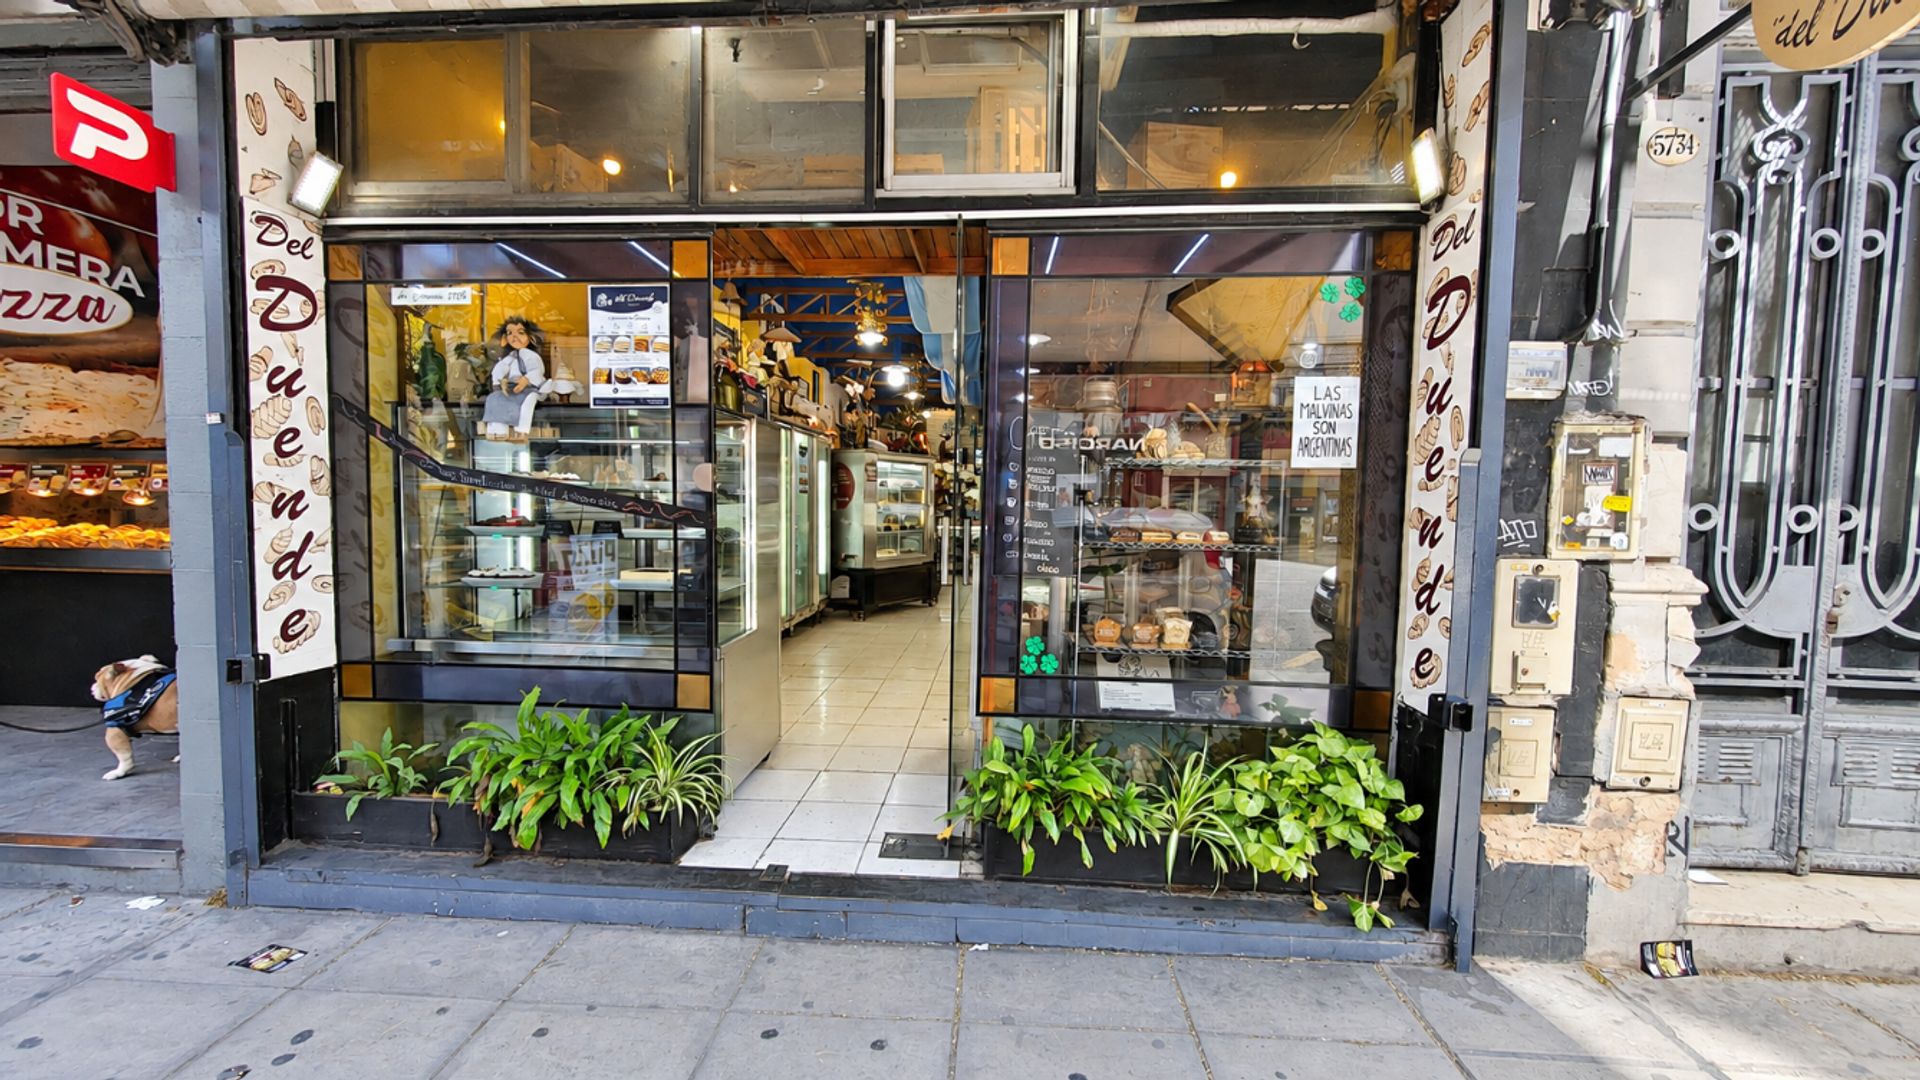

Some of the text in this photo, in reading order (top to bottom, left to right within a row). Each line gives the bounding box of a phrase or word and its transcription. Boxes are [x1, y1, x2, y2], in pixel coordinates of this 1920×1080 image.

[1653, 132, 1695, 156] 5734
[0, 195, 44, 235] R
[255, 213, 315, 260] Del
[1433, 208, 1476, 262] Del
[1314, 385, 1342, 401] LAS
[1300, 403, 1353, 419] MALVINAS
[1313, 421, 1337, 435] SON
[1297, 436, 1353, 458] ARGENTINAS
